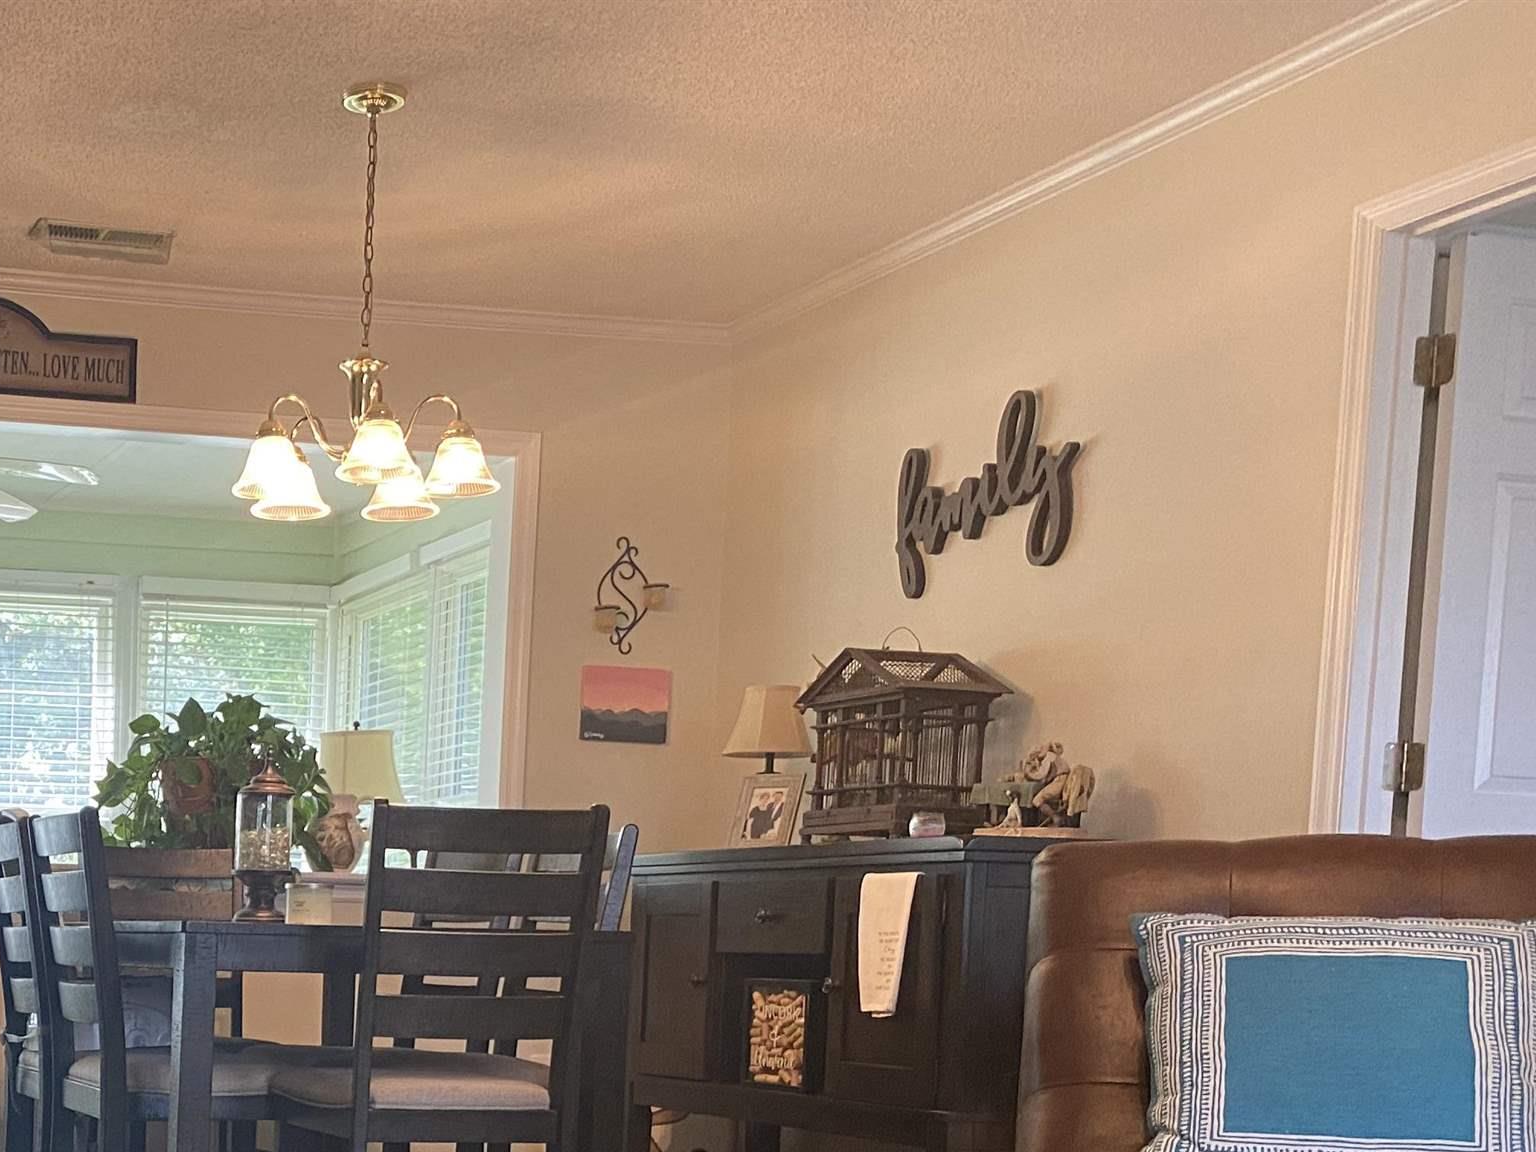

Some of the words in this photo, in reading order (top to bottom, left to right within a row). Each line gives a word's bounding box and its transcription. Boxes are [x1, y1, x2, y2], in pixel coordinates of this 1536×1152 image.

[43, 352, 80, 381] LOVE
[84, 356, 125, 385] MUCH
[896, 390, 1080, 599] family
